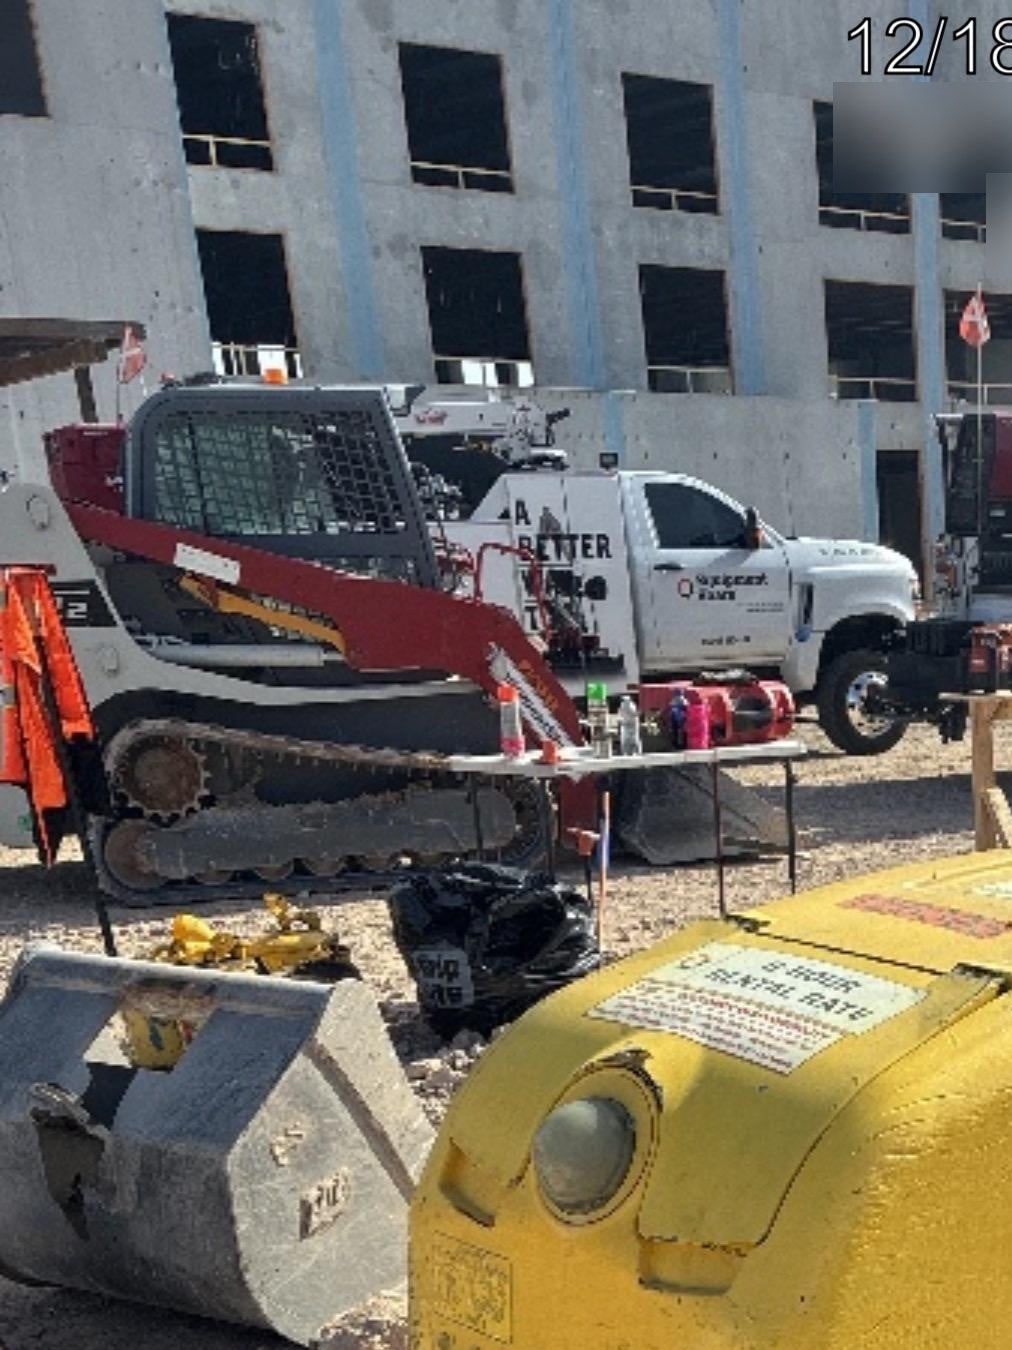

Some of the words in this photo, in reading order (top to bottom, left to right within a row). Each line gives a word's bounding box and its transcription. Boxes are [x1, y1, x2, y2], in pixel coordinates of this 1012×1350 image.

[514, 499, 531, 526] A
[518, 533, 612, 561] BETTER
[704, 967, 797, 999] RENTAL
[797, 992, 874, 1021] RATE
